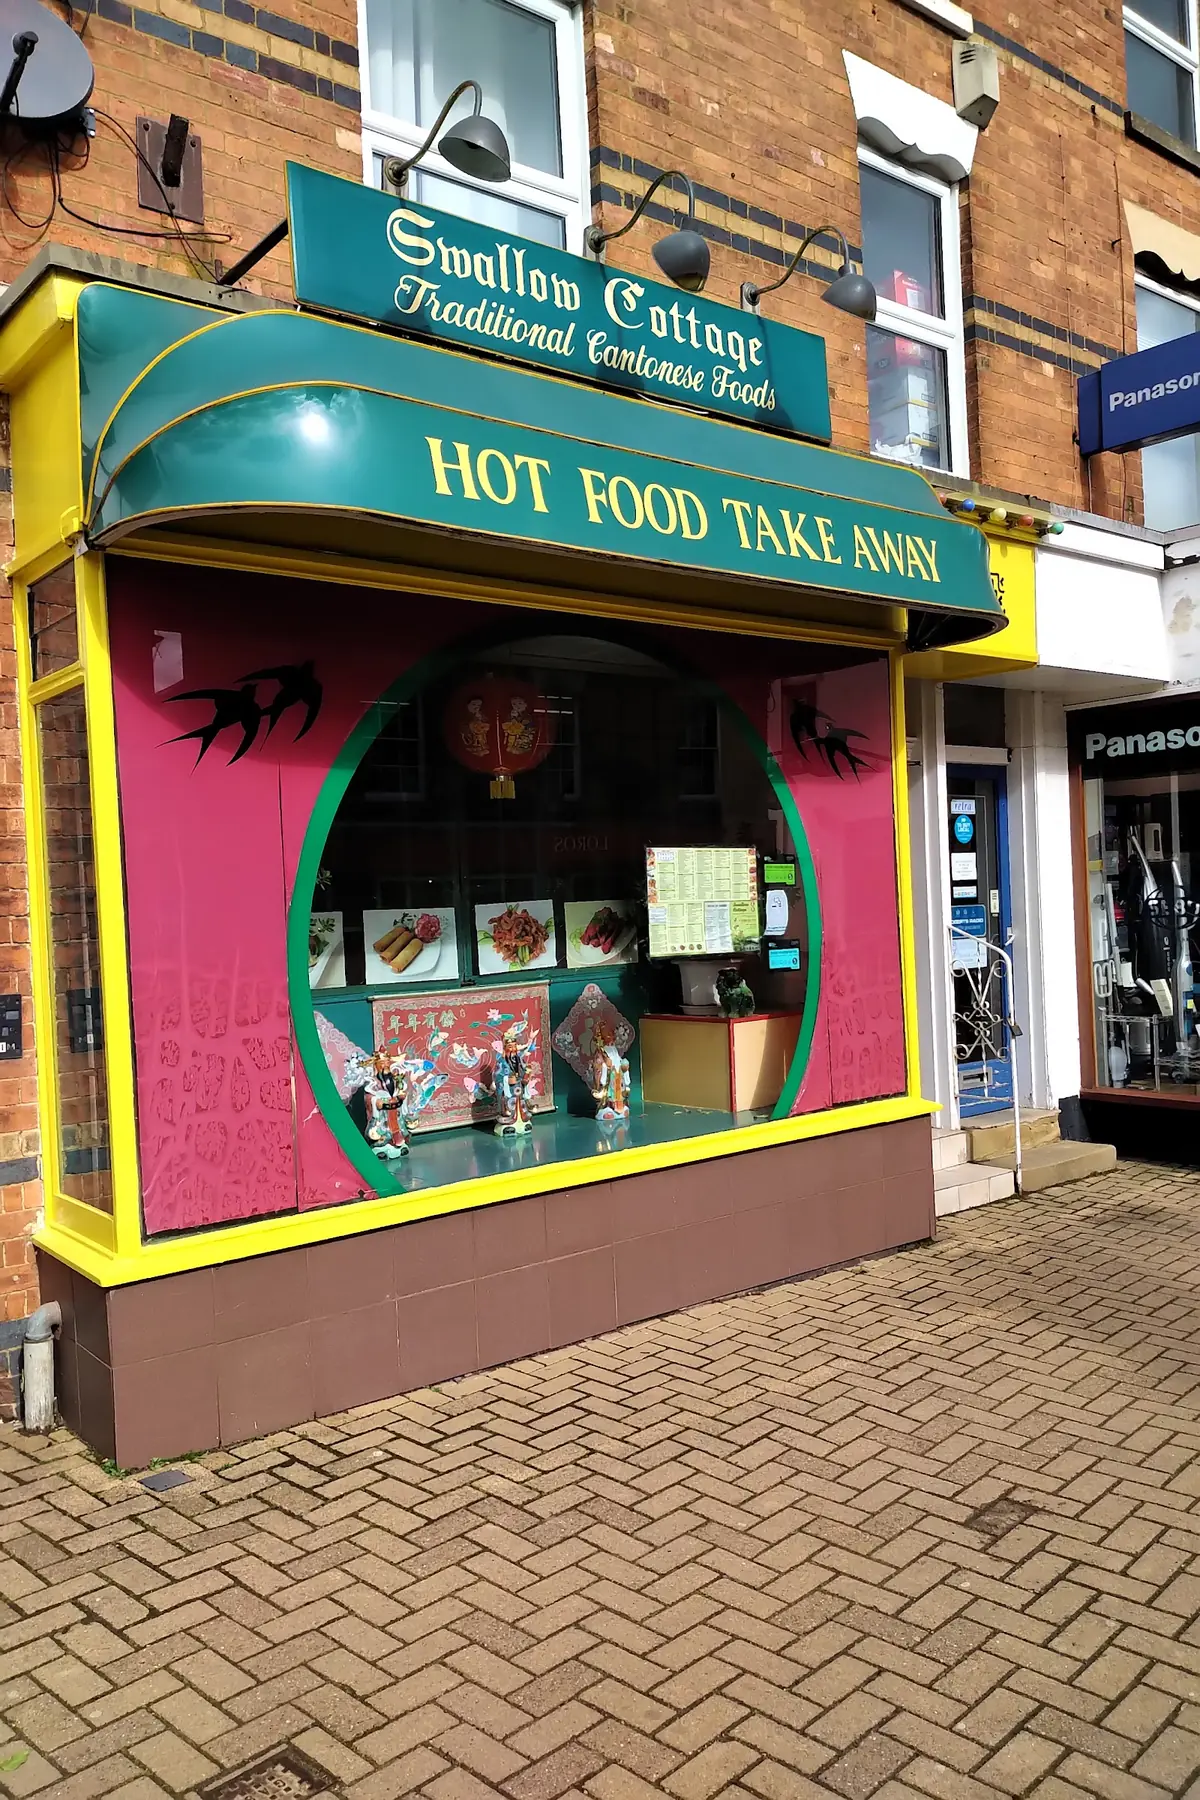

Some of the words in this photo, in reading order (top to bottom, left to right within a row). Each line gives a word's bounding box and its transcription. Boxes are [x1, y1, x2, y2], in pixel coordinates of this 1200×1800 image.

[386, 208, 581, 311] Swallow
[604, 277, 763, 373] Cottage
[394, 274, 576, 357] Traditional
[586, 329, 705, 392] Cantonese
[711, 365, 776, 411] Foods
[424, 436, 551, 513] HOT
[577, 467, 708, 540] FOOD
[722, 498, 842, 565] TAKE
[853, 524, 941, 583] AWAY
[1085, 726, 1200, 760] Panaso
